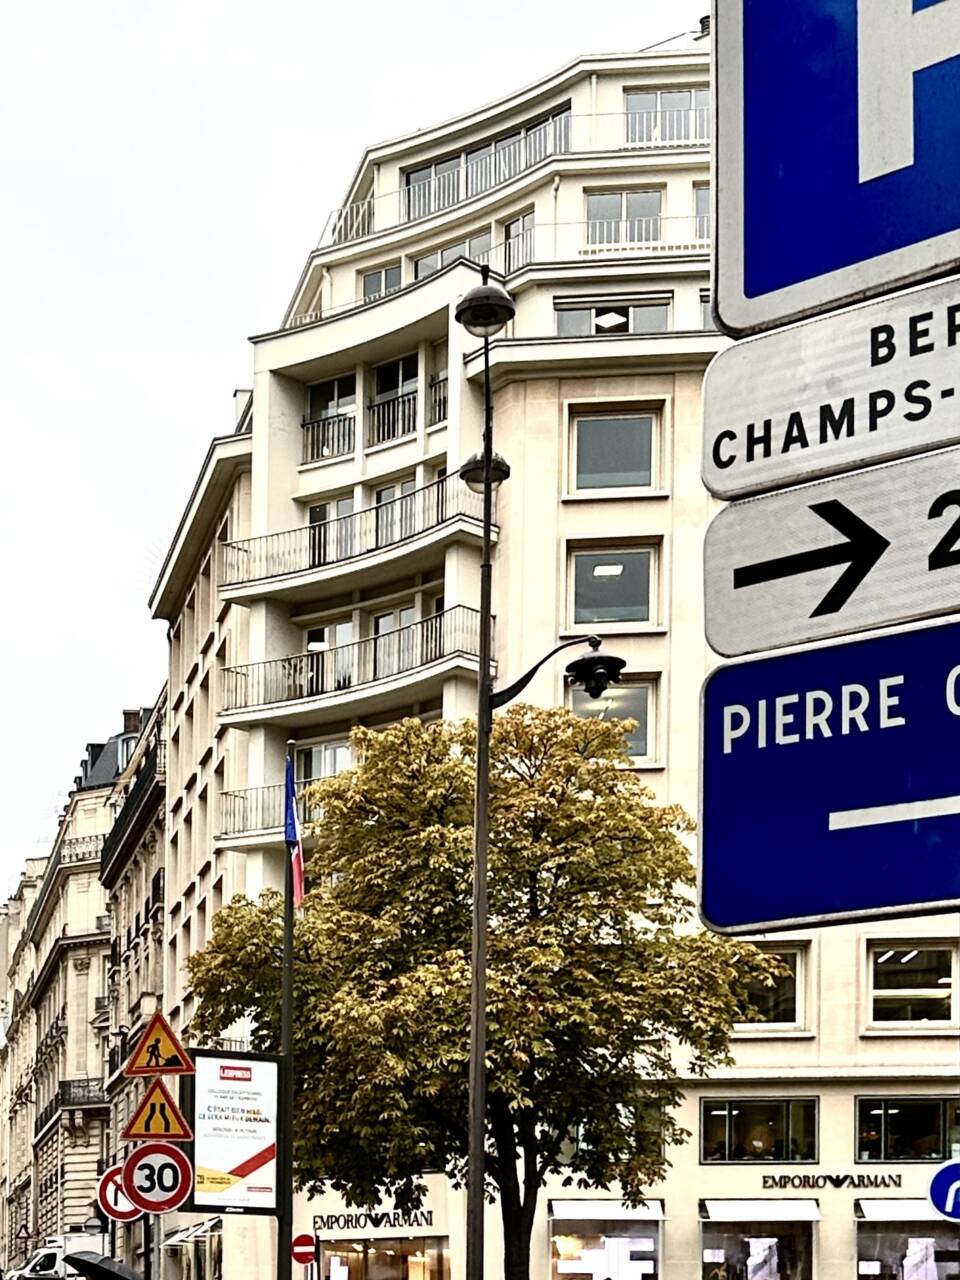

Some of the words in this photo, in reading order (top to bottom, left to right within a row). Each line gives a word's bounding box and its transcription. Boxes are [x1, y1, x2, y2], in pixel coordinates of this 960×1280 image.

[712, 379, 954, 469] CHAMPS-
[723, 675, 906, 754] PIERRE
[136, 1162, 180, 1194] 30
[762, 1174, 827, 1189] EMPORIO
[846, 1174, 903, 1188] ARMANI
[313, 1213, 368, 1230] EMPORIO
[383, 1210, 434, 1228] ARMANI
